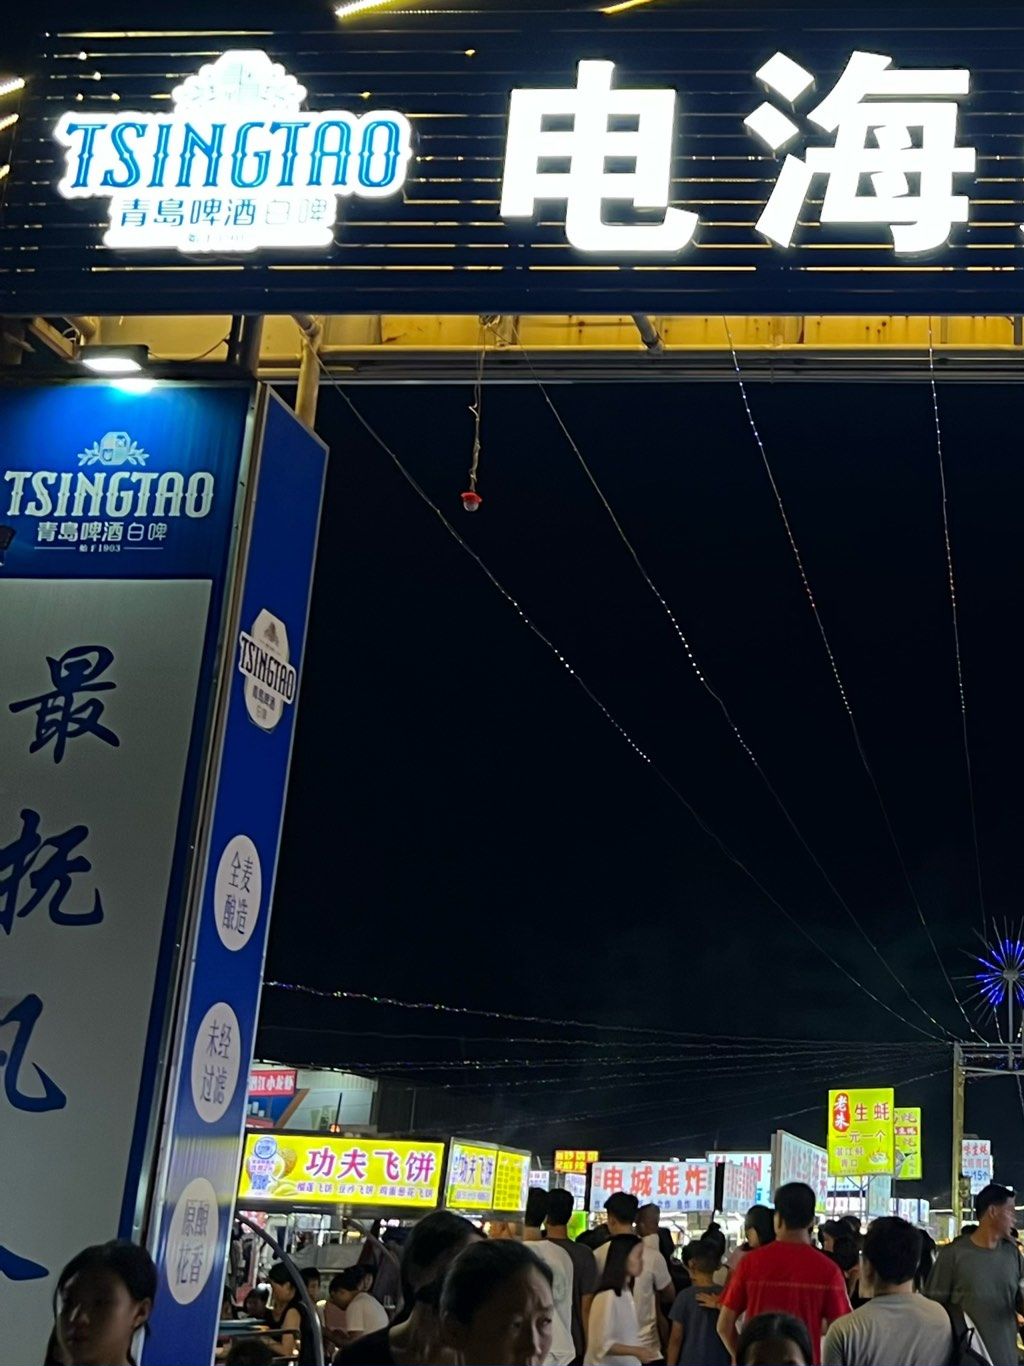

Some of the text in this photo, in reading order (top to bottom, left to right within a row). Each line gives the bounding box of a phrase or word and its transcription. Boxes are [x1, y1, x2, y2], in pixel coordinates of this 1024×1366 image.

[66, 120, 401, 188] TSINGTAO
[4, 470, 214, 518] TSINGTAO
[241, 636, 296, 701] TSINGTAO
[229, 851, 253, 893] 全麦
[207, 1019, 232, 1059] 未经
[855, 1102, 889, 1121] 生蚝
[836, 1130, 886, 1144] 一元一个
[306, 1148, 434, 1183] 功夫飞饼
